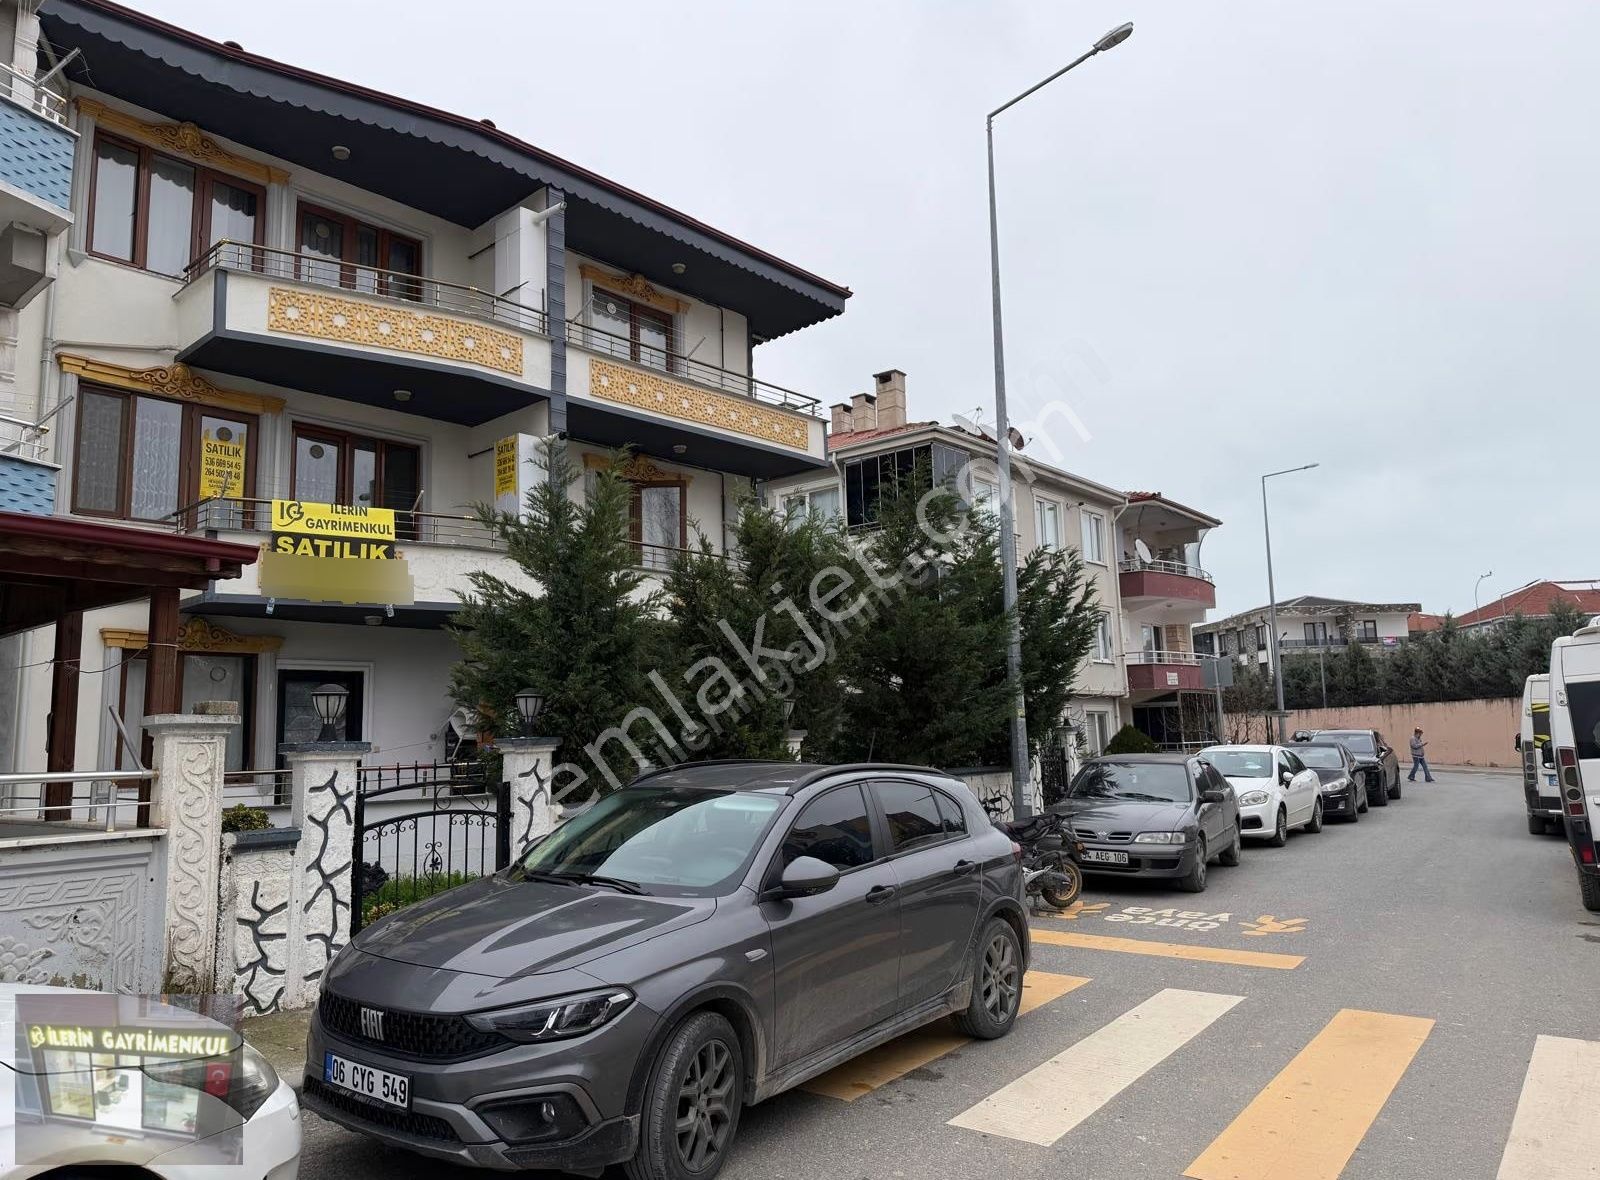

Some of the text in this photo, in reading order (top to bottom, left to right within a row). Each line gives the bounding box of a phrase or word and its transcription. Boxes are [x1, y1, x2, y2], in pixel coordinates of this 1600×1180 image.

[205, 442, 241, 458] SATILIK
[305, 517, 393, 535] GAYRİMENKUL
[276, 536, 390, 560] SATILIK
[1113, 853, 1127, 863] 106
[361, 1007, 384, 1041] FIAT
[332, 1058, 345, 1084] 06
[352, 1065, 375, 1093] CYG
[382, 1074, 407, 1104] 549
